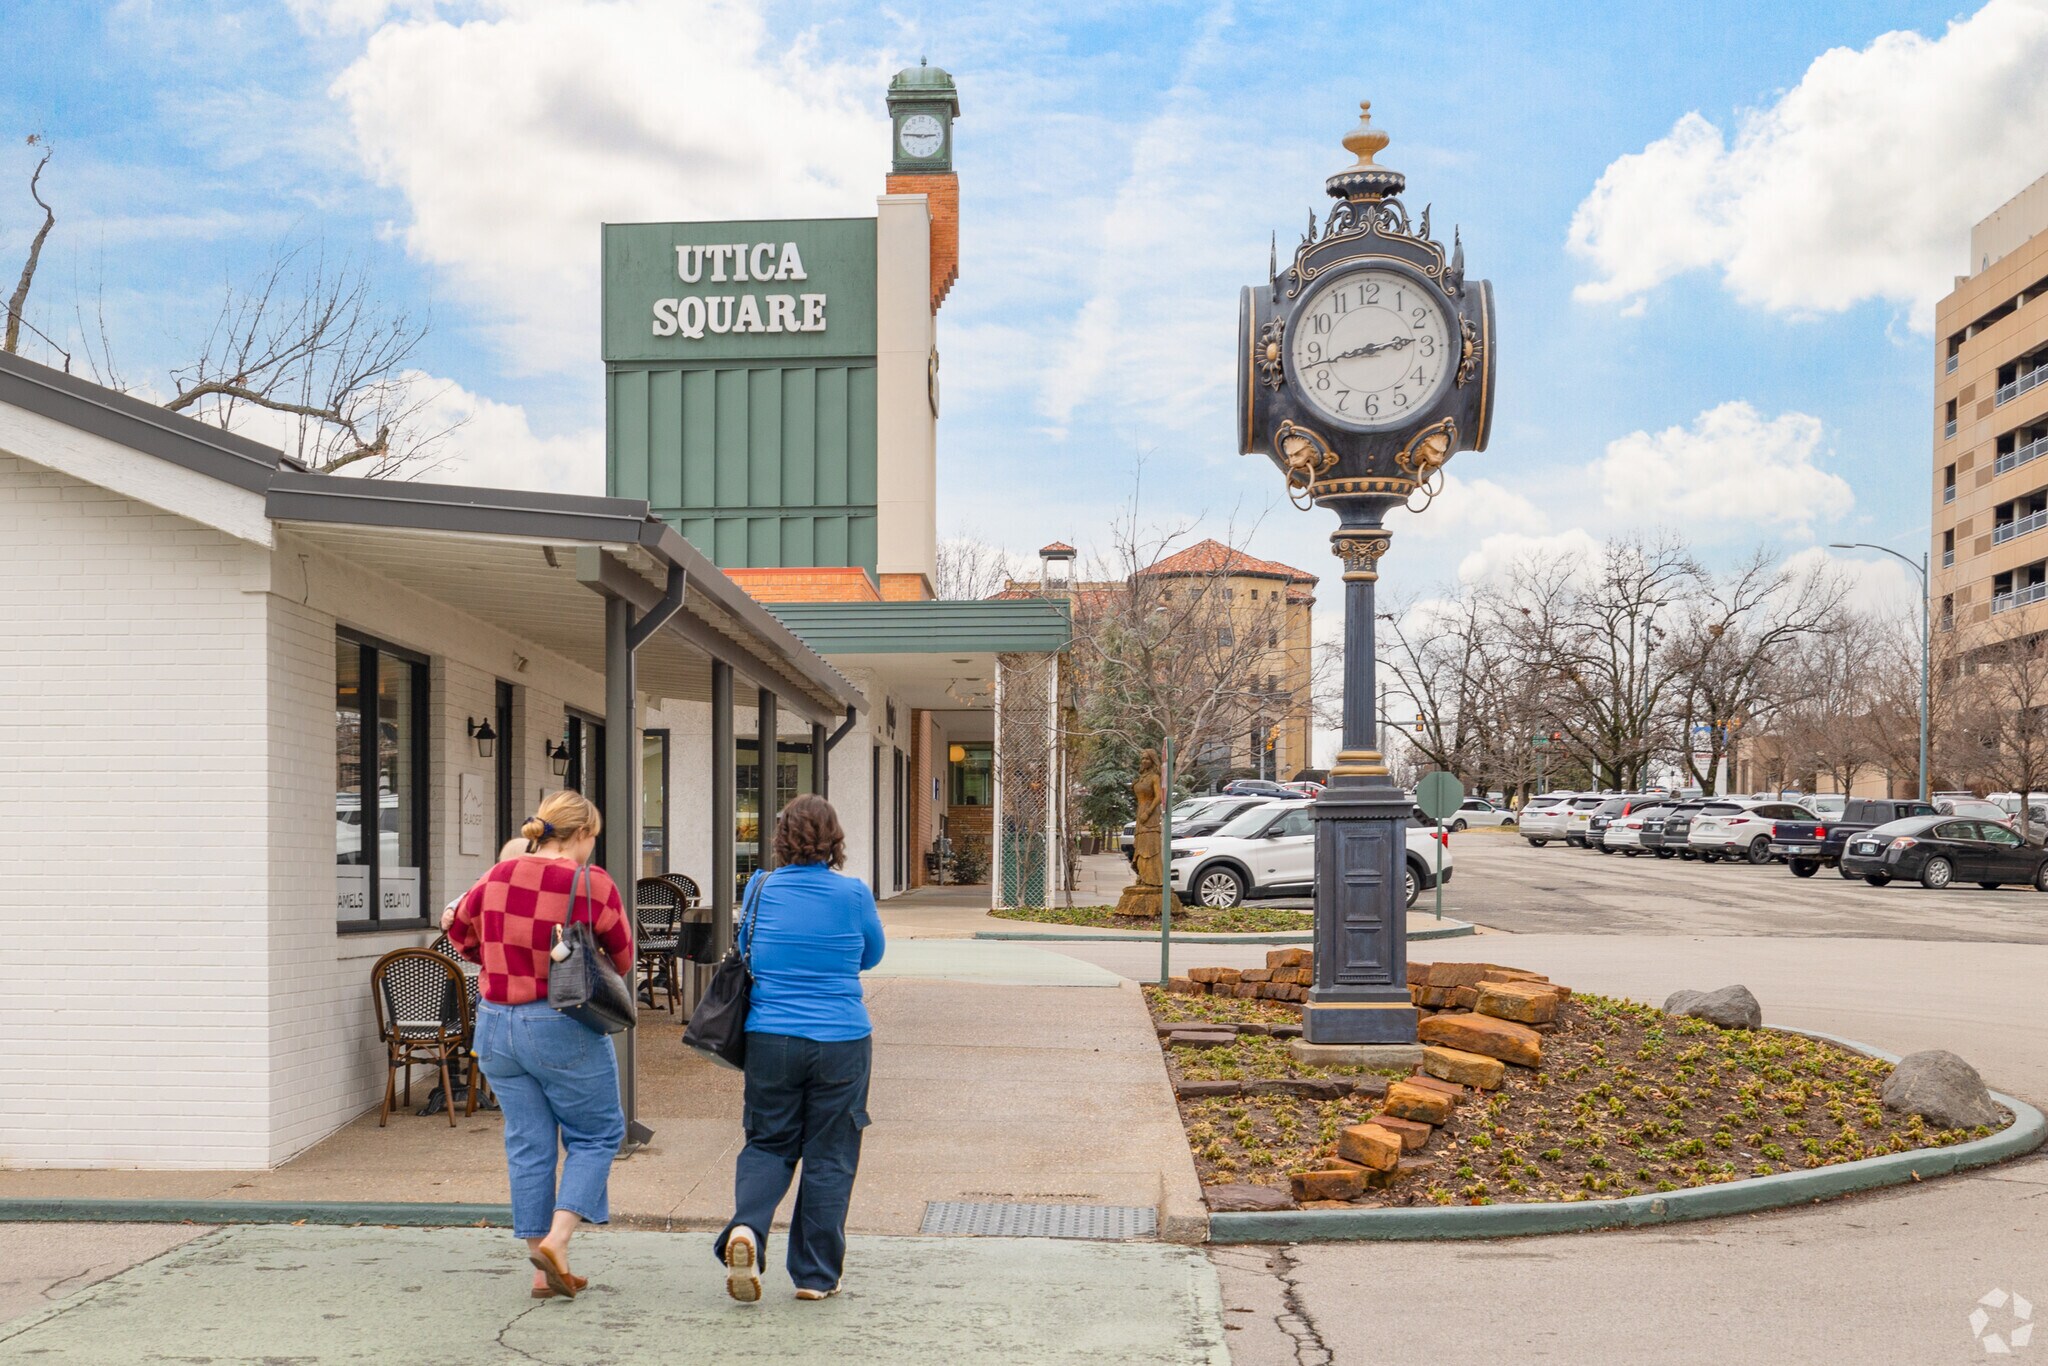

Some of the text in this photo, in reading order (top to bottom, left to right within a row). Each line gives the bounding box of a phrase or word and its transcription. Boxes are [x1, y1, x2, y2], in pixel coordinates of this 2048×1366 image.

[675, 242, 808, 283] UTICA
[1333, 292, 1347, 314] 11
[1359, 283, 1380, 306] 12
[1396, 291, 1404, 312] 1
[652, 293, 827, 339] SQUARE
[1312, 313, 1331, 335] 10
[1412, 307, 1427, 330] 2
[1307, 341, 1322, 364] 9
[1419, 335, 1435, 358] 3
[1316, 370, 1331, 391] 8
[1409, 365, 1427, 387] 4
[1335, 390, 1350, 412] 7
[1364, 394, 1380, 416] 6
[1393, 384, 1408, 407] 5
[384, 892, 411, 909] GELATO
